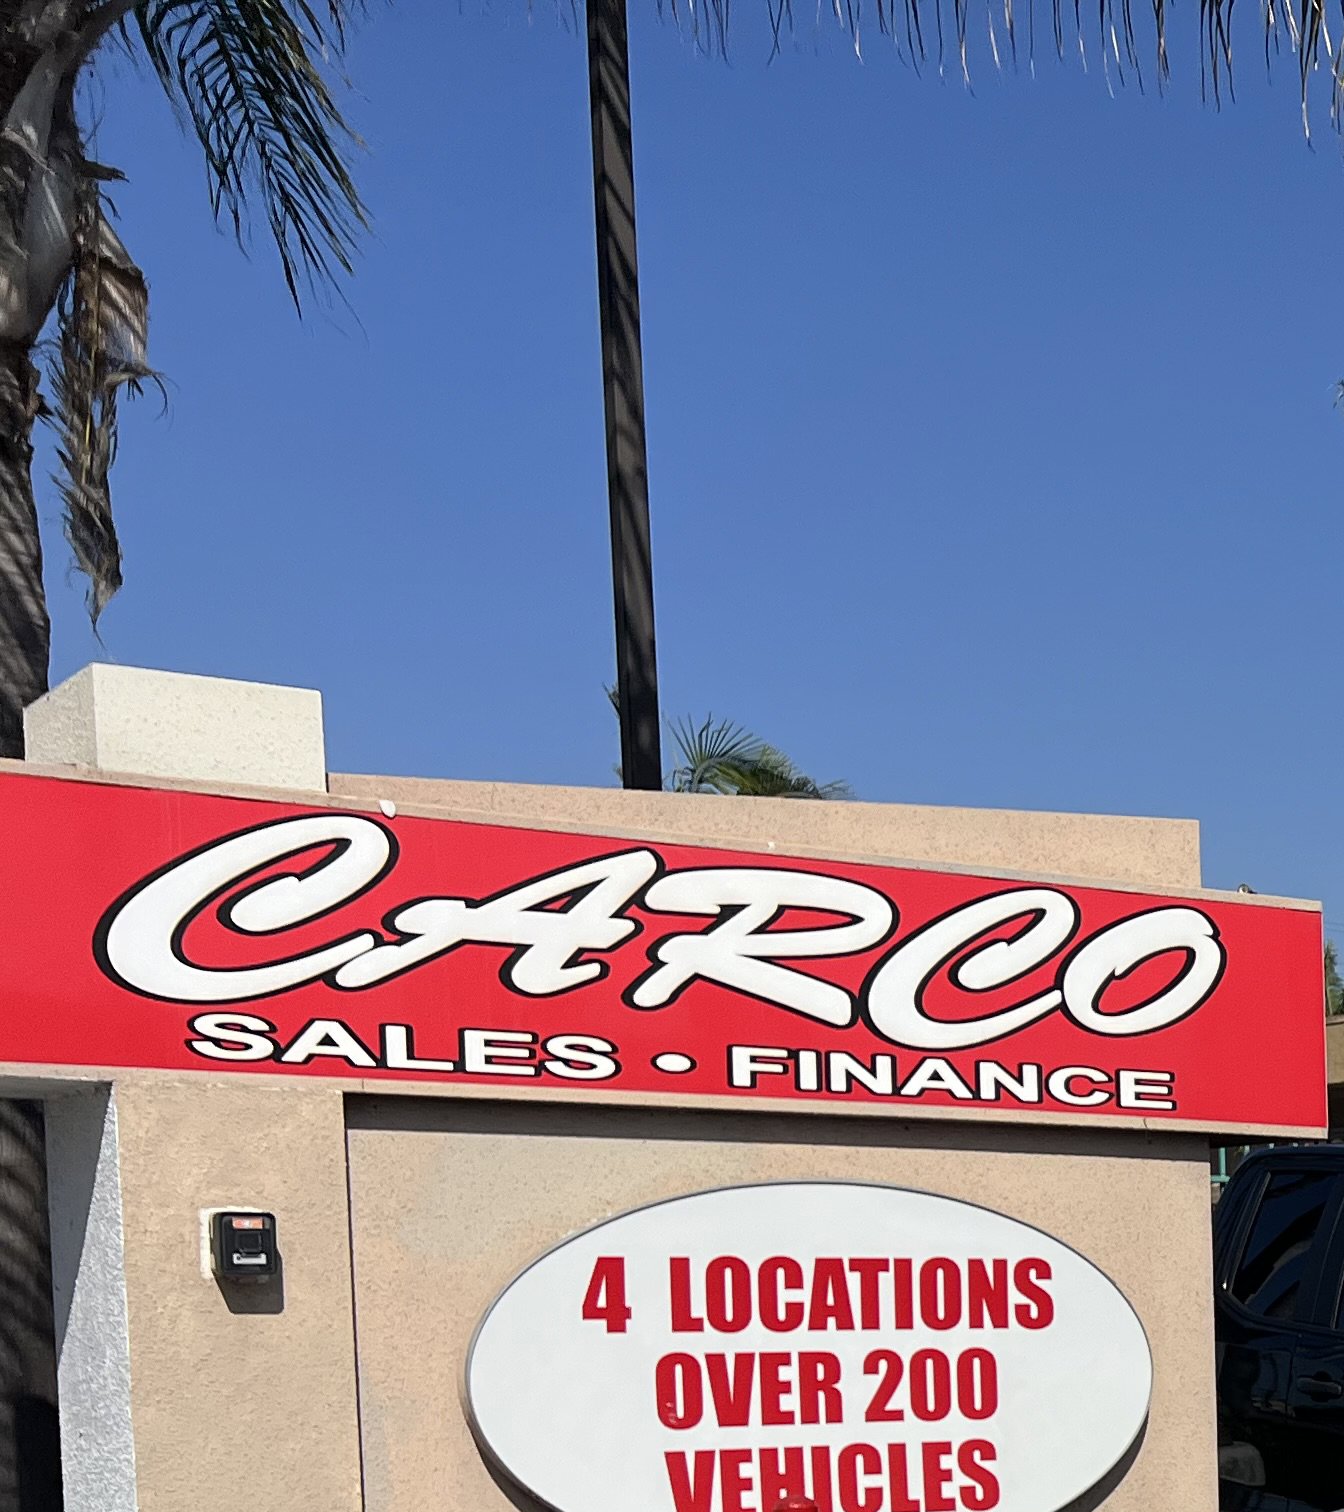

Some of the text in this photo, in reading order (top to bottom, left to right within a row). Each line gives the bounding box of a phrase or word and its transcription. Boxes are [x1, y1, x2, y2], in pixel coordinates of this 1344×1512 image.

[94, 811, 1226, 1051] CARCO
[188, 1012, 1180, 1112] SALES FINANCE
[582, 1256, 1055, 1333] 4 LOCATIONS
[655, 1347, 999, 1430] OVER 200
